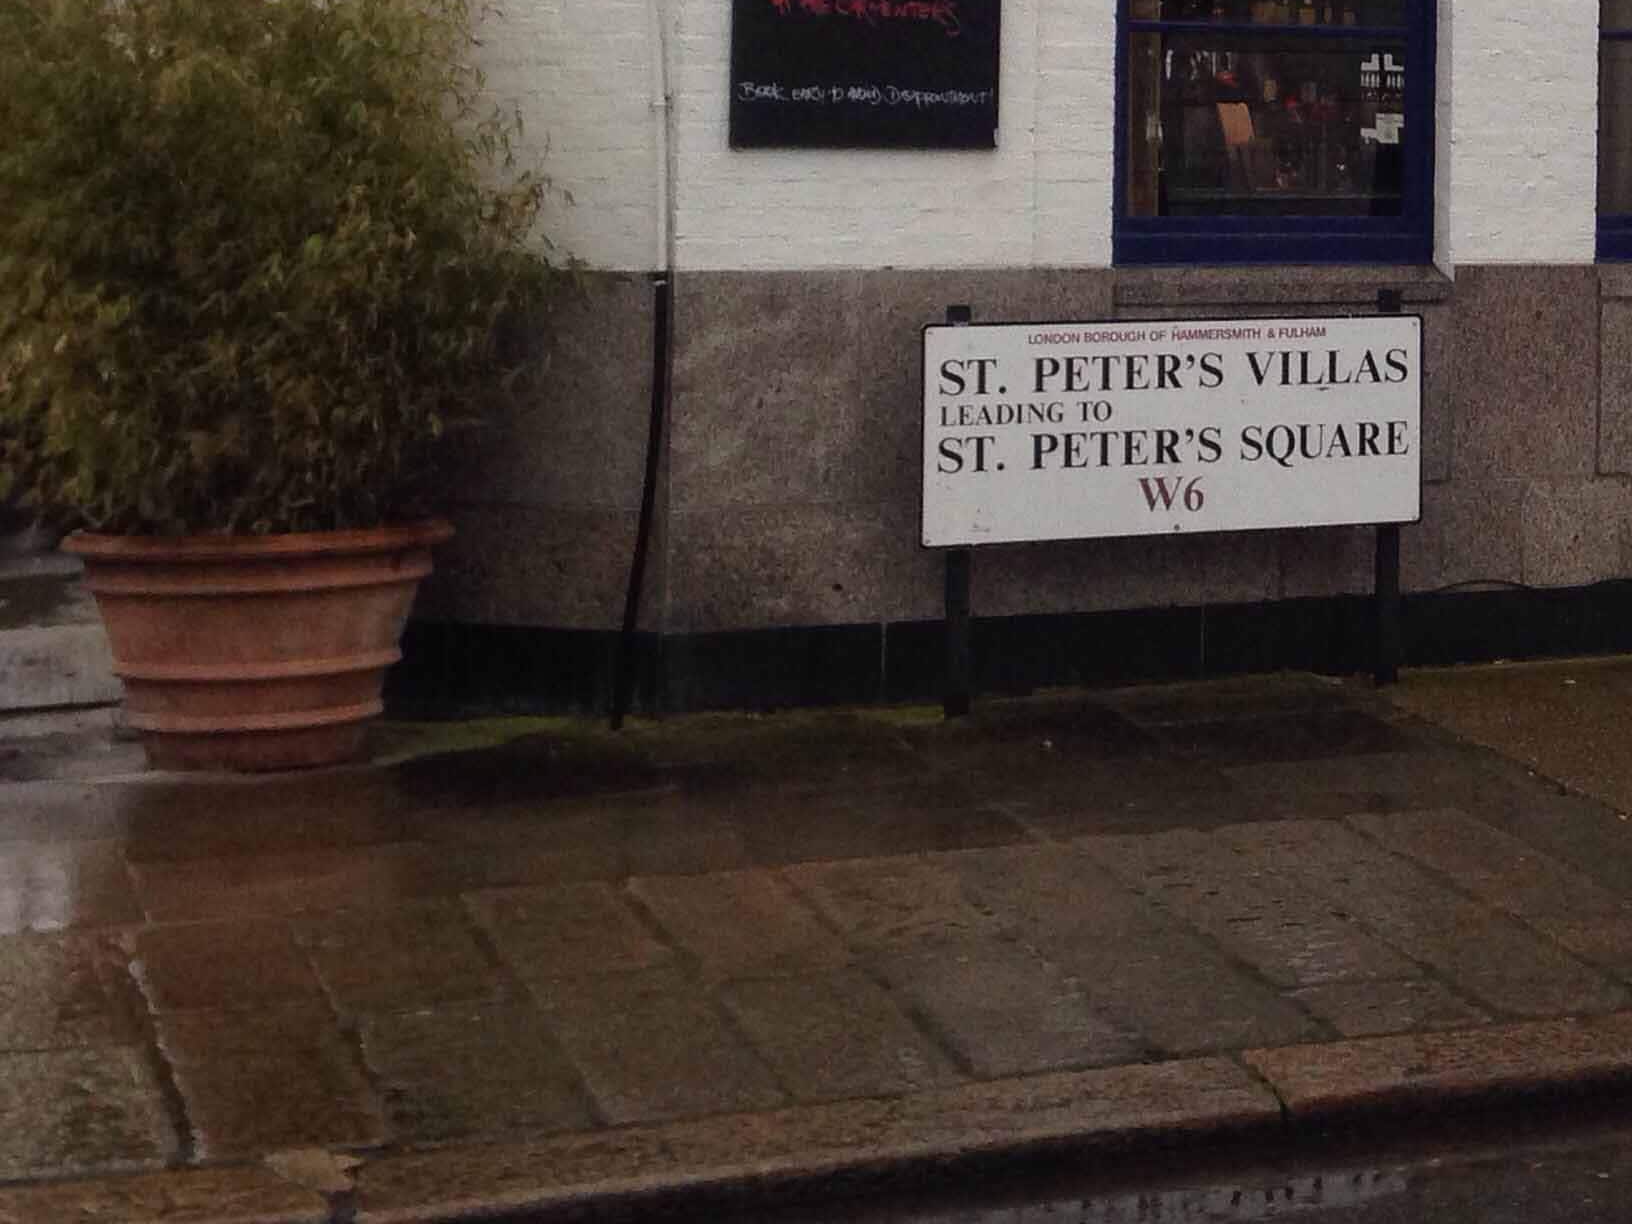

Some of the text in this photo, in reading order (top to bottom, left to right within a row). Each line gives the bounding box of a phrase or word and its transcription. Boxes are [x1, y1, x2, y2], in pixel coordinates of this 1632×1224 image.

[1028, 326, 1327, 345] LONDON BOROUGH OF HAMMERSMITH & FULHAM
[938, 347, 1410, 396] ST. PETER'S VILLAS
[940, 400, 1113, 427] LEADING TO
[937, 420, 1410, 474] ST. PETER'S SQUARE
[1138, 475, 1205, 513] W6
